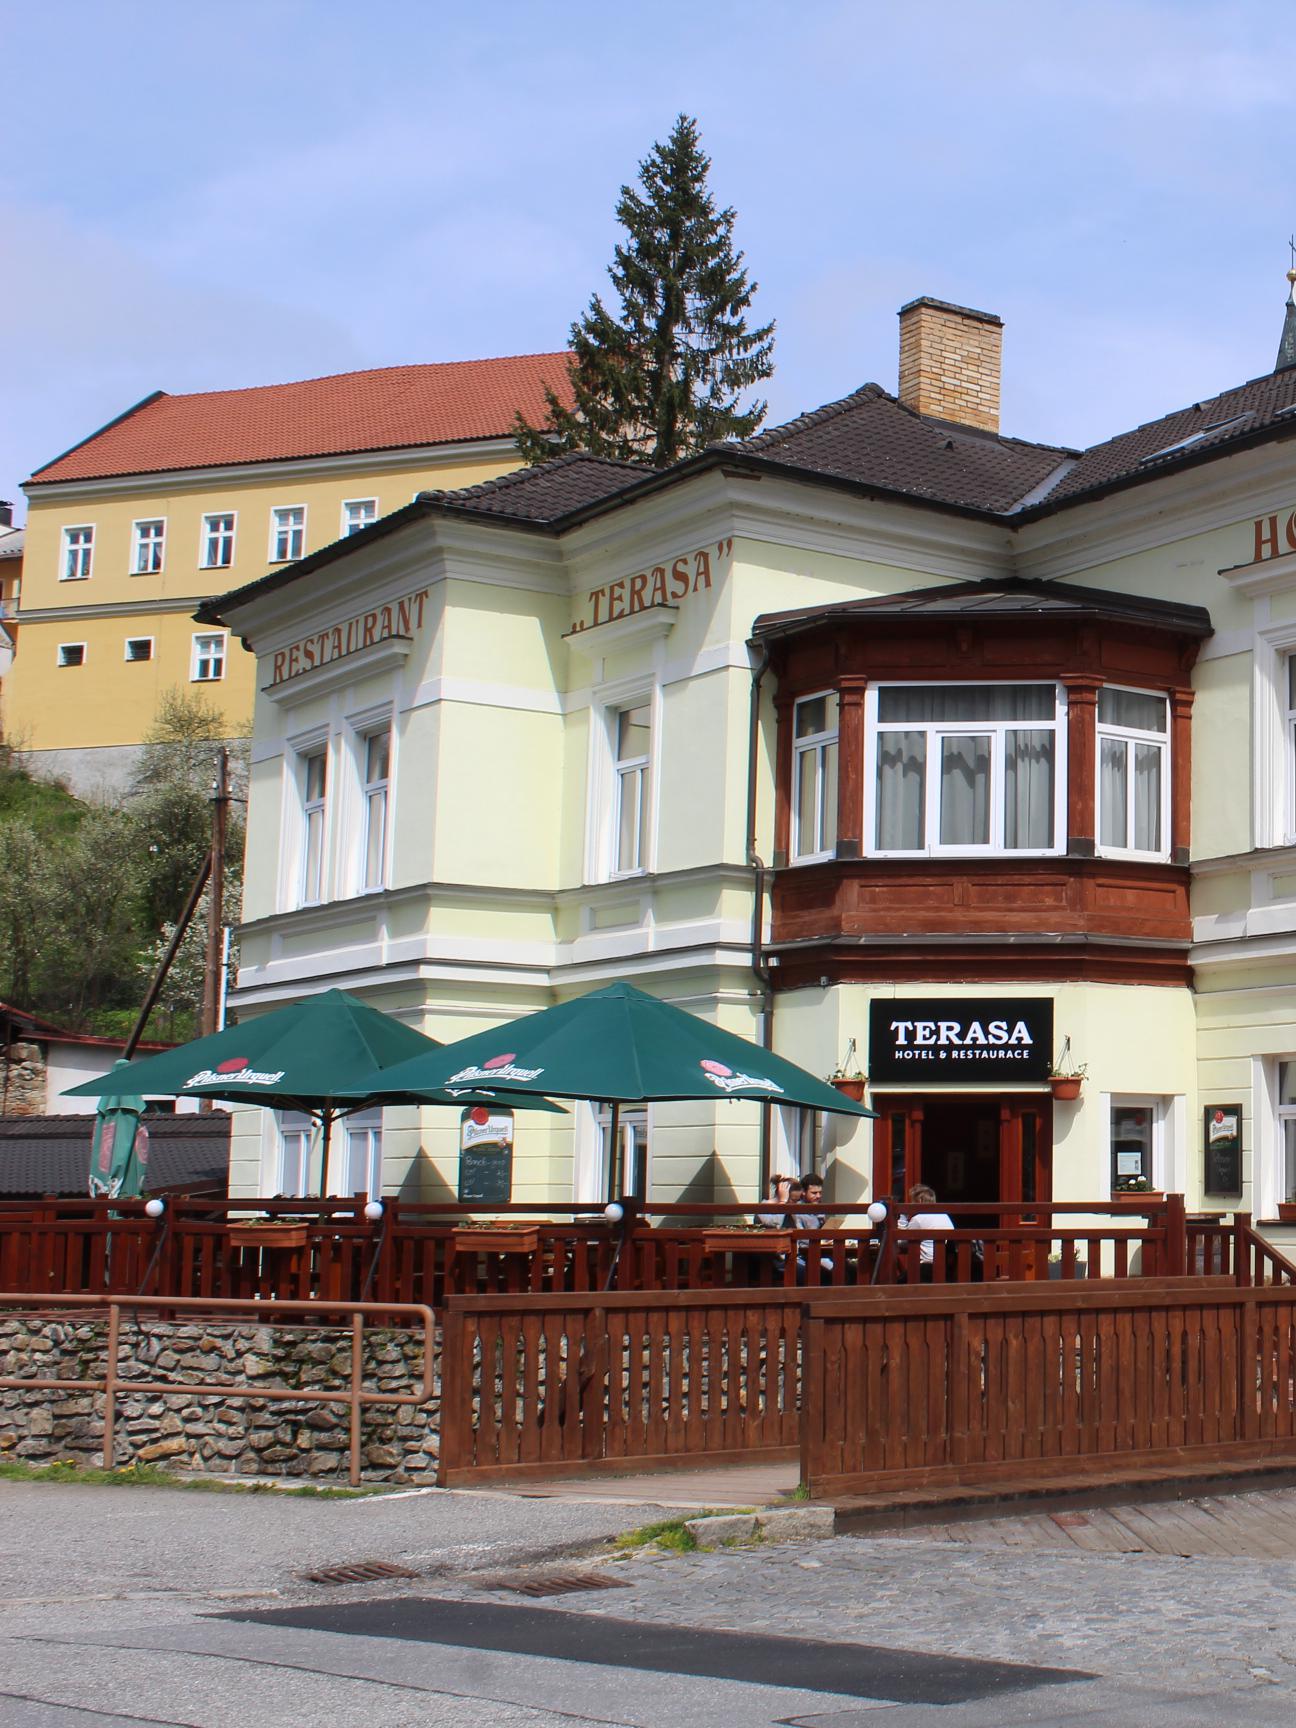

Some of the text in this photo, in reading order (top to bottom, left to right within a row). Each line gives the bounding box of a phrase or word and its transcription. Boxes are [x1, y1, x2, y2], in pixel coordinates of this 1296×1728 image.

[273, 589, 429, 686] RESTAURANT
[890, 1021, 1033, 1045] TERASA
[895, 1050, 1030, 1059] HOTEL & RESTAURACE
